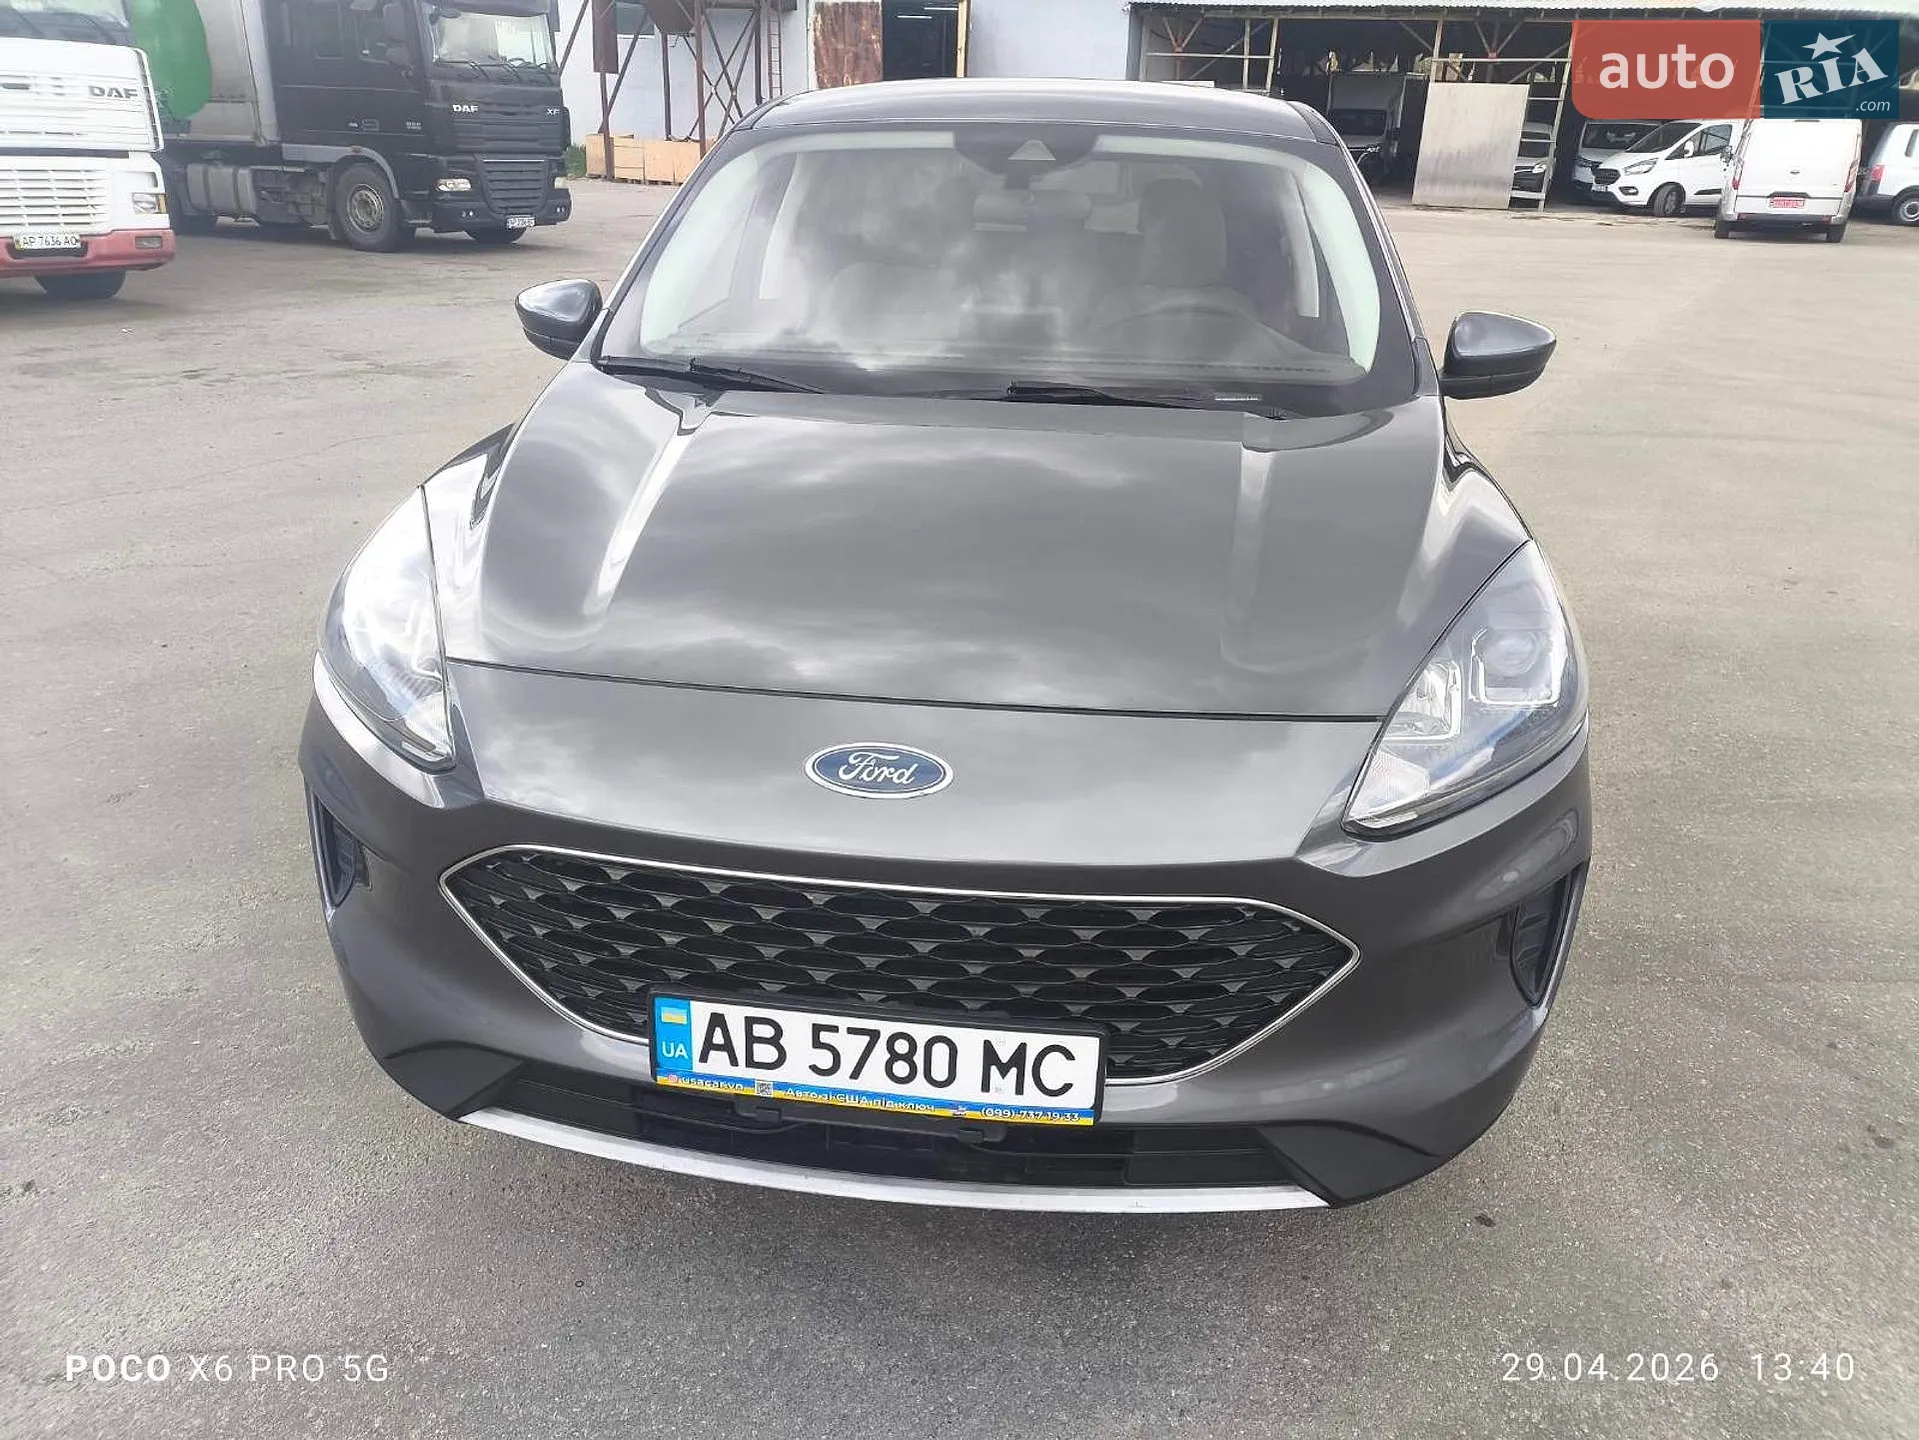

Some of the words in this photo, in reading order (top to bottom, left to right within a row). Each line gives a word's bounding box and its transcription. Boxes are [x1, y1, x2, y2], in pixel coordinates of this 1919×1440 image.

[87, 85, 138, 99] DAF
[452, 104, 479, 113] DAF
[22, 236, 36, 246] AP
[838, 751, 919, 785] Ford
[662, 1041, 688, 1059] UA
[698, 1012, 787, 1070] AB
[808, 1022, 958, 1088] 5780
[981, 1039, 1076, 1097] MC
[836, 1092, 869, 1106] США
[1019, 1110, 1043, 1120] 737
[1047, 1112, 1060, 1121] 19
